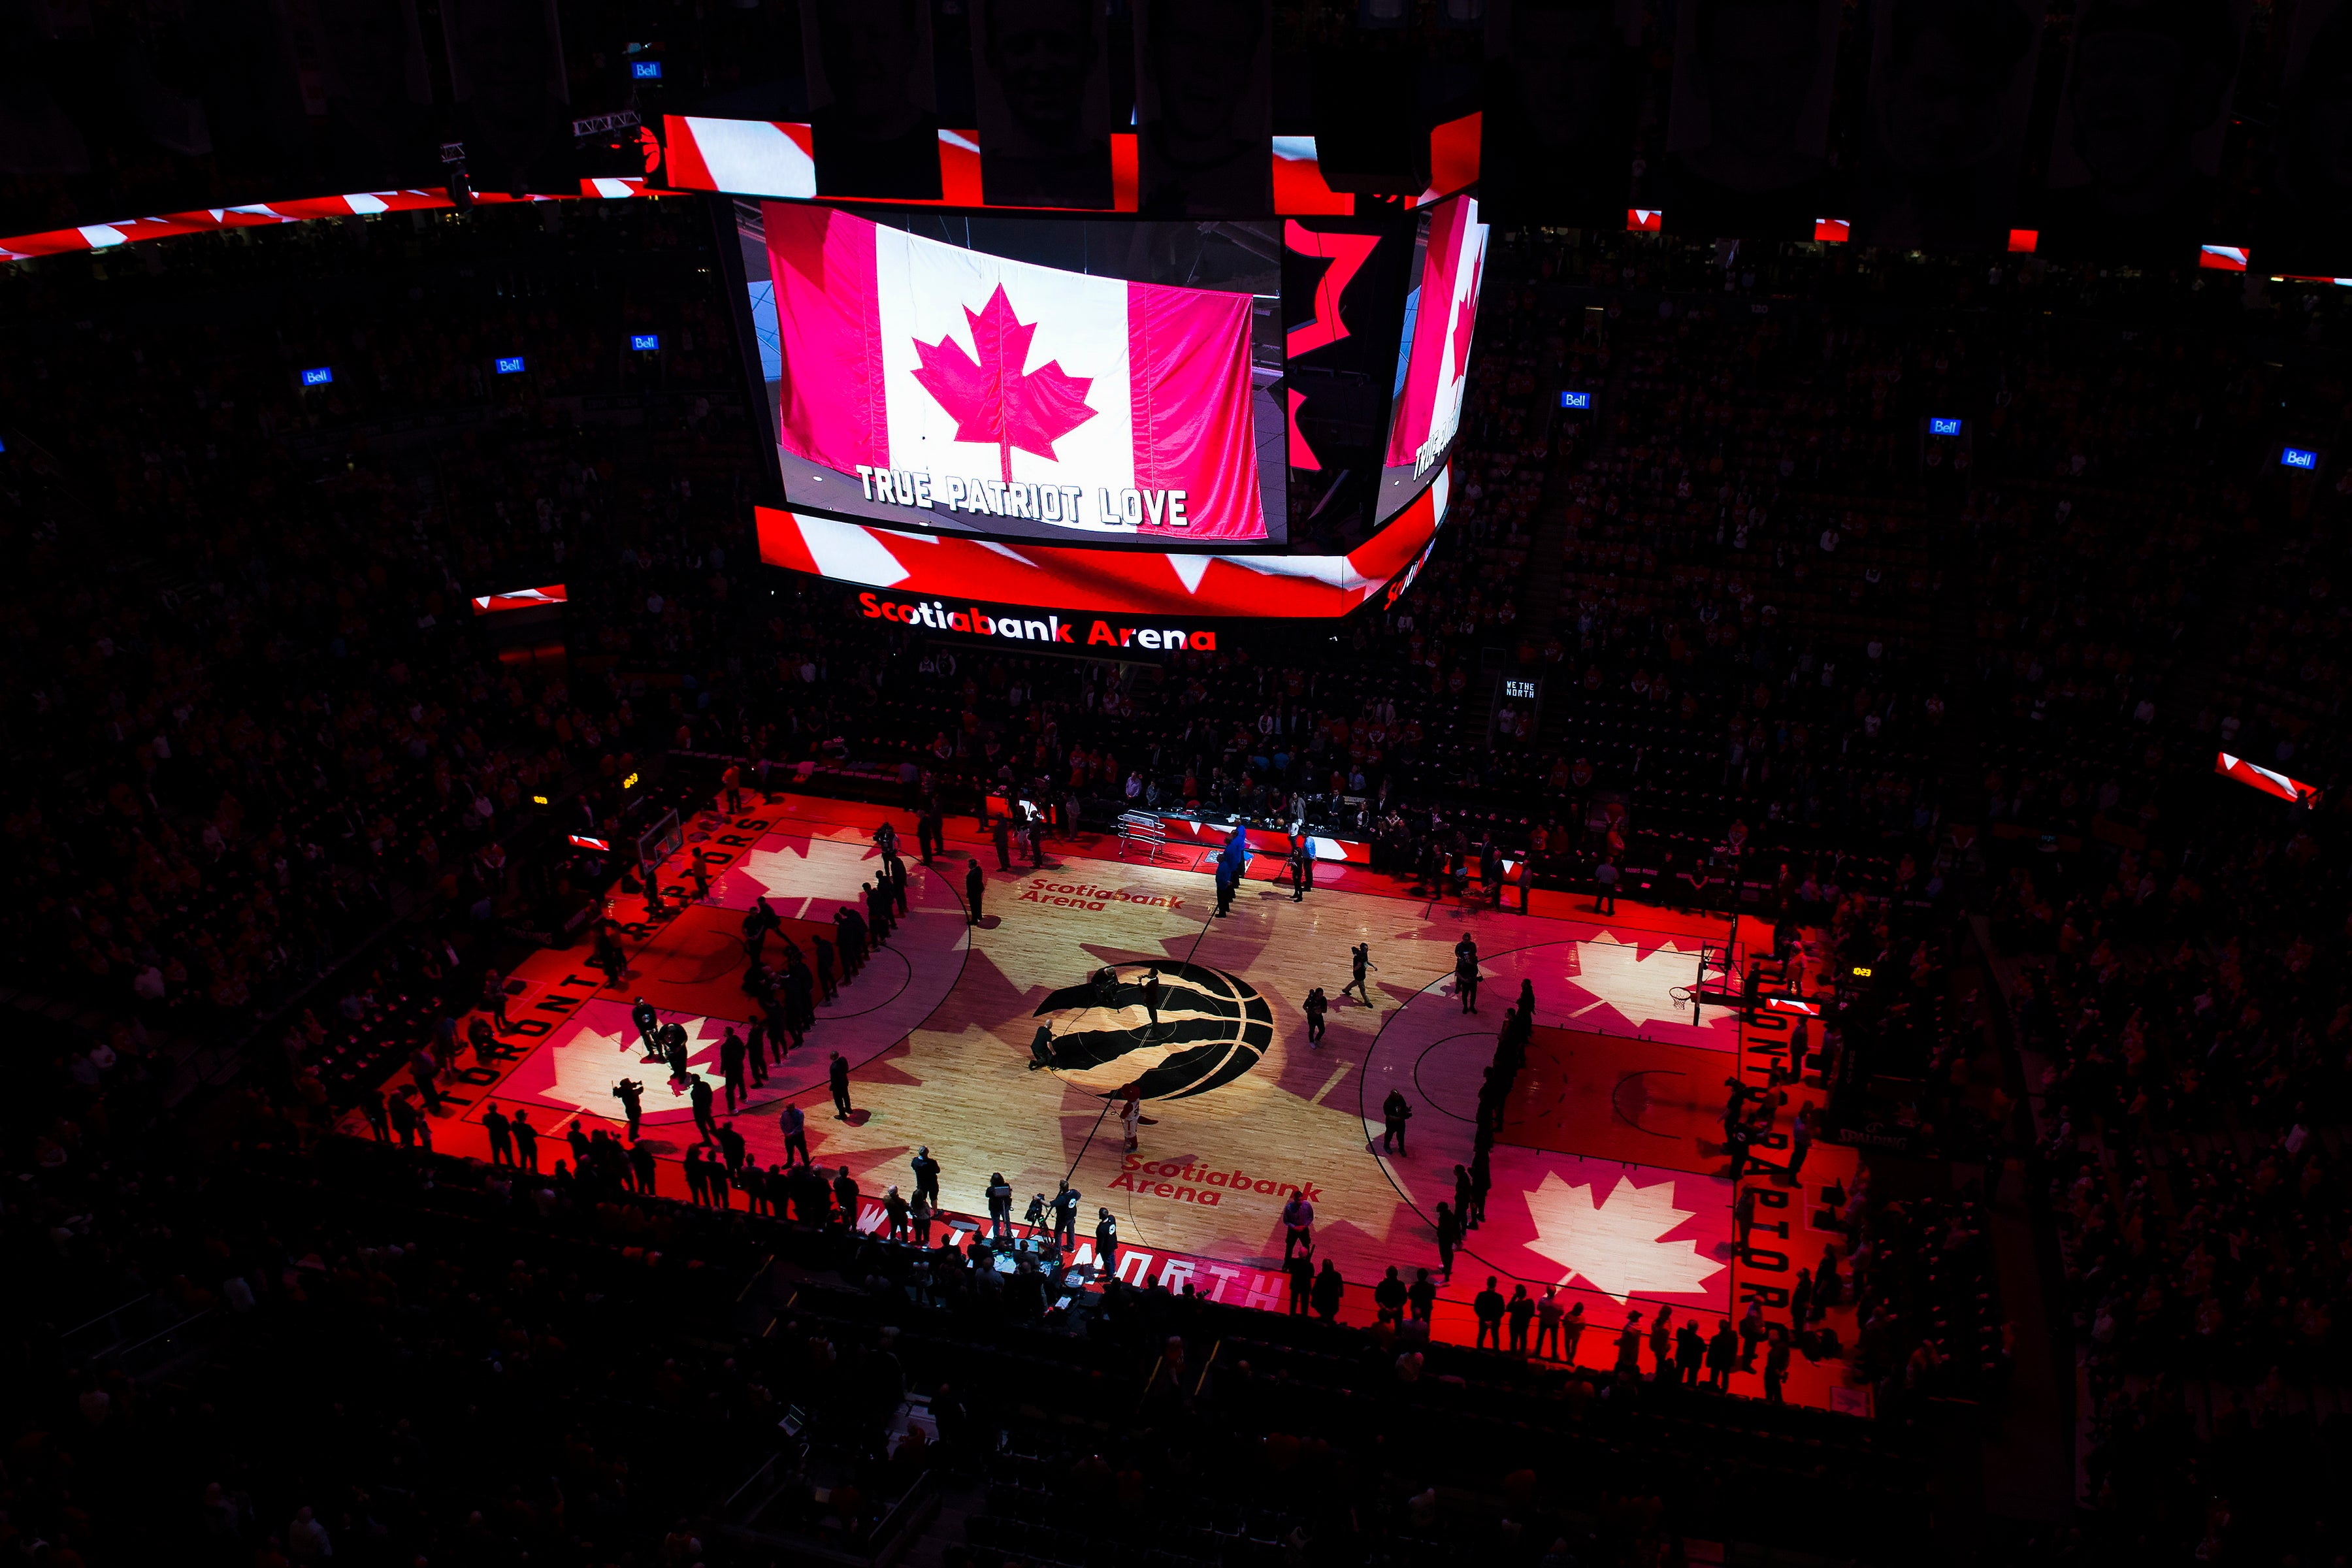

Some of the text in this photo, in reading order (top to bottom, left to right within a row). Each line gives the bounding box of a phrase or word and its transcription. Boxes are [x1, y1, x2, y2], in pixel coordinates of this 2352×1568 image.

[636, 64, 657, 76] Bell
[635, 337, 655, 348] Bell
[500, 359, 520, 371] Bell
[306, 370, 327, 382] Bell
[1566, 394, 1586, 406] Bell
[1935, 420, 1957, 433] Bell
[2287, 451, 2311, 466] Bell
[855, 465, 1189, 527] TRUE PATRIOT LOVE
[858, 592, 1216, 651] Scotiabank Arena
[1506, 688, 1534, 698] NORTH
[1518, 682, 1535, 691] THE
[1017, 890, 1106, 912] Arena
[1028, 879, 1185, 909] Scotiabank
[1838, 1128, 1909, 1151] SPALDING
[1121, 1154, 1324, 1203] Scotiabank
[1107, 1173, 1222, 1206] Arena
